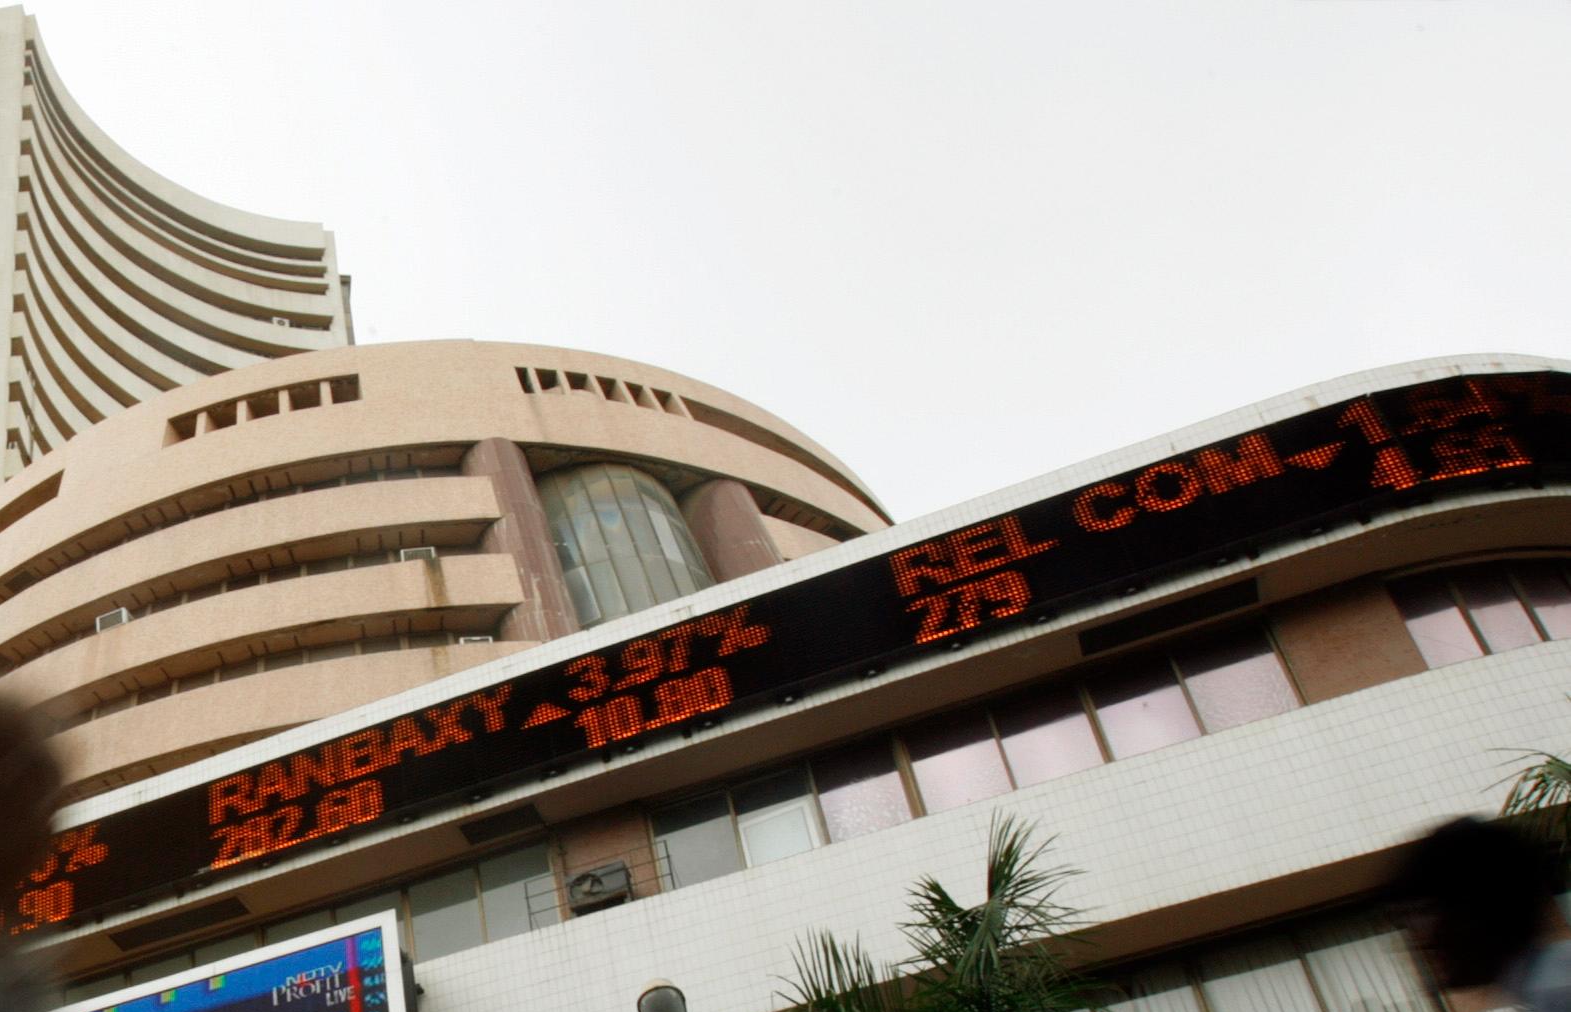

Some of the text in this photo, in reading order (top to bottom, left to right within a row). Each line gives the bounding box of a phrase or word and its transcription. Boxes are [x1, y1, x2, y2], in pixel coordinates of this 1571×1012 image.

[888, 514, 1060, 597] REL
[1072, 432, 1284, 532] COM
[905, 570, 1032, 644] 279
[208, 603, 772, 825] RANBAXY 3.97%
[271, 972, 341, 1006] PROFIT
[285, 961, 343, 986] NDTV
[326, 985, 356, 1007] LIVE
